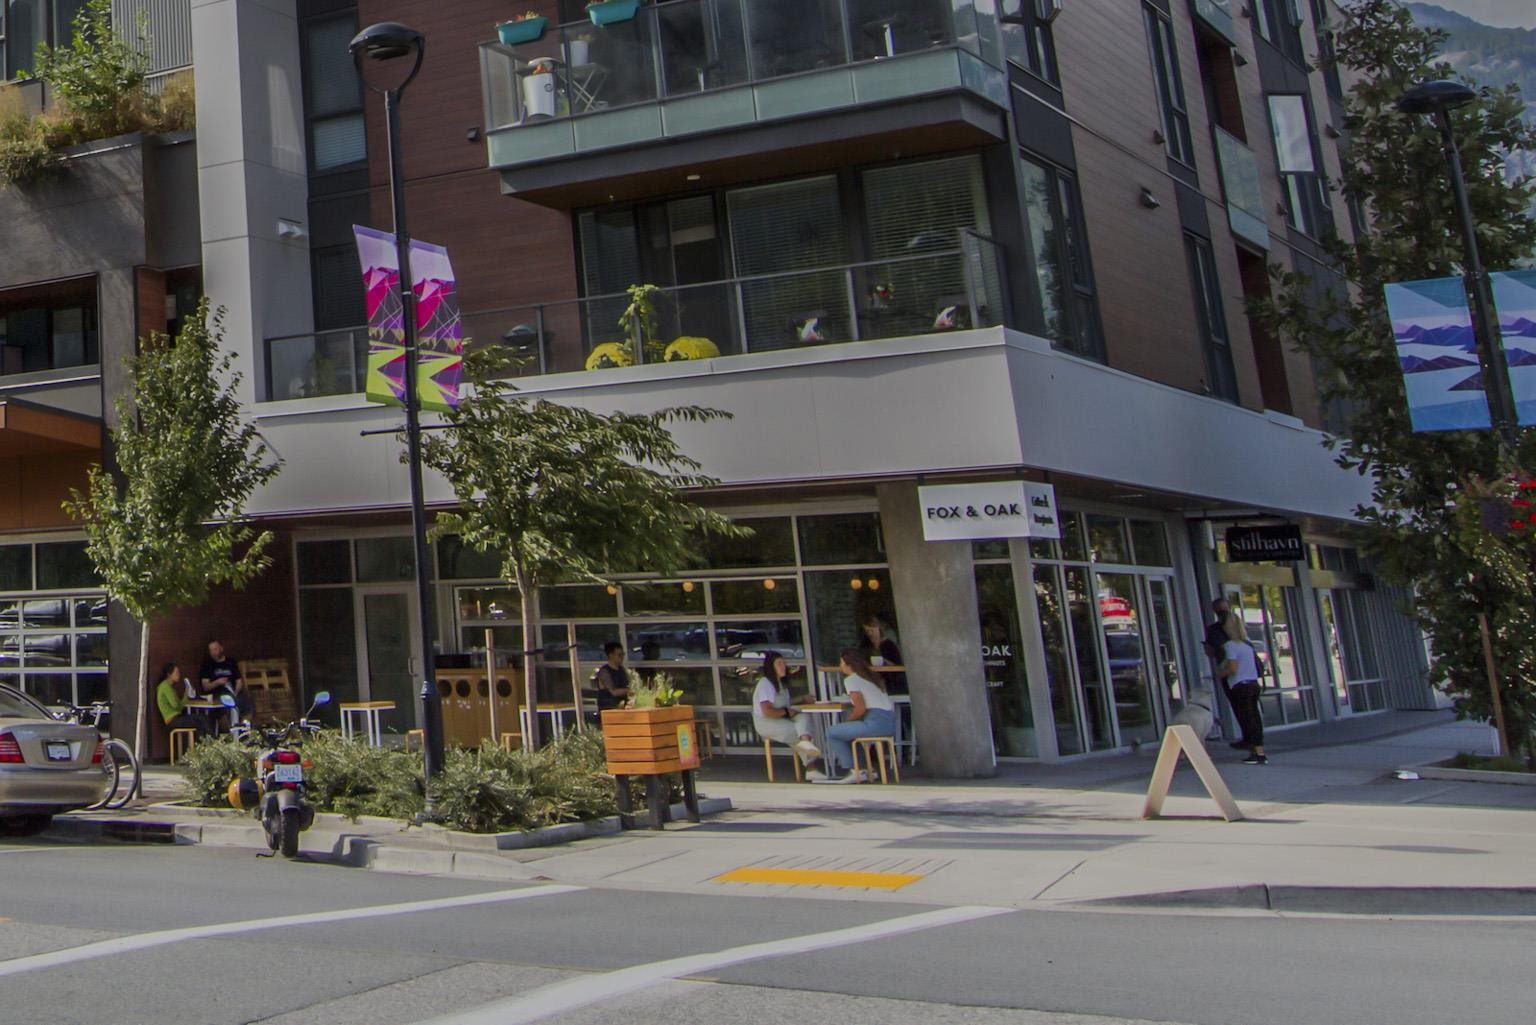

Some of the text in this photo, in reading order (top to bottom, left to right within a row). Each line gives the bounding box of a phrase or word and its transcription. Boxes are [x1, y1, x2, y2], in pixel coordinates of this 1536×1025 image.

[927, 503, 1021, 520] FOX & OAK
[982, 645, 1012, 656] OAK
